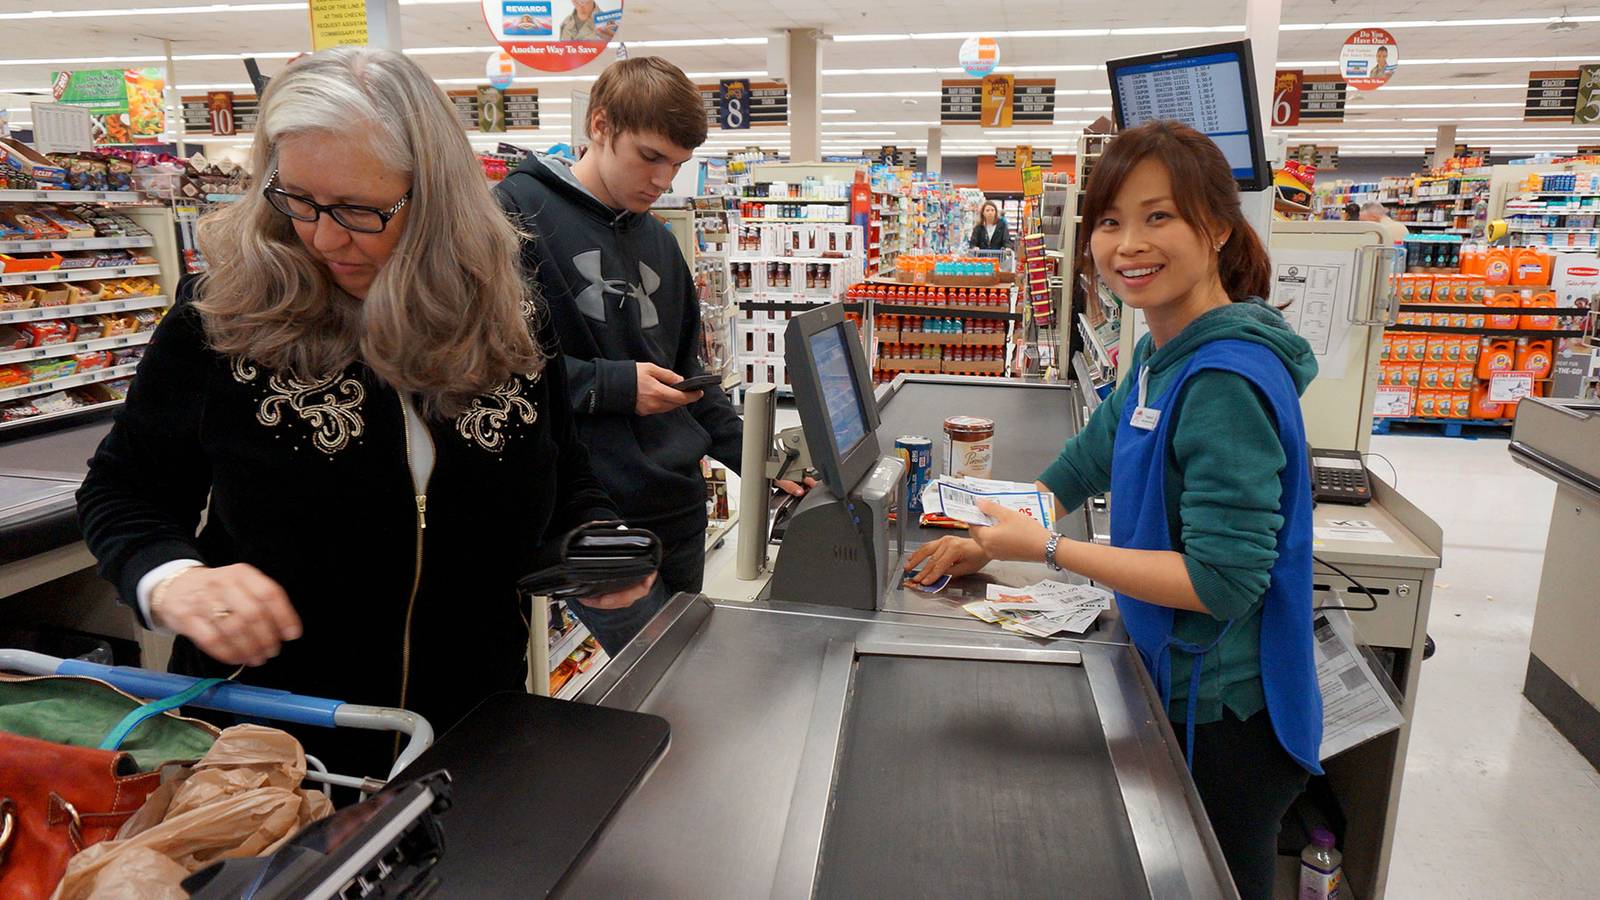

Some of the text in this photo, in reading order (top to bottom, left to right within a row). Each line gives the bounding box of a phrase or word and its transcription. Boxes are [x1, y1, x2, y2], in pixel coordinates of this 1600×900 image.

[511, 46, 545, 54] Another
[546, 46, 564, 56] Way
[578, 46, 597, 54] Save
[484, 102, 496, 132] 9
[727, 99, 743, 128] 8
[991, 95, 1006, 126] 7
[1273, 89, 1291, 125] 6
[1584, 89, 1600, 121] 5
[210, 109, 231, 135] 10
